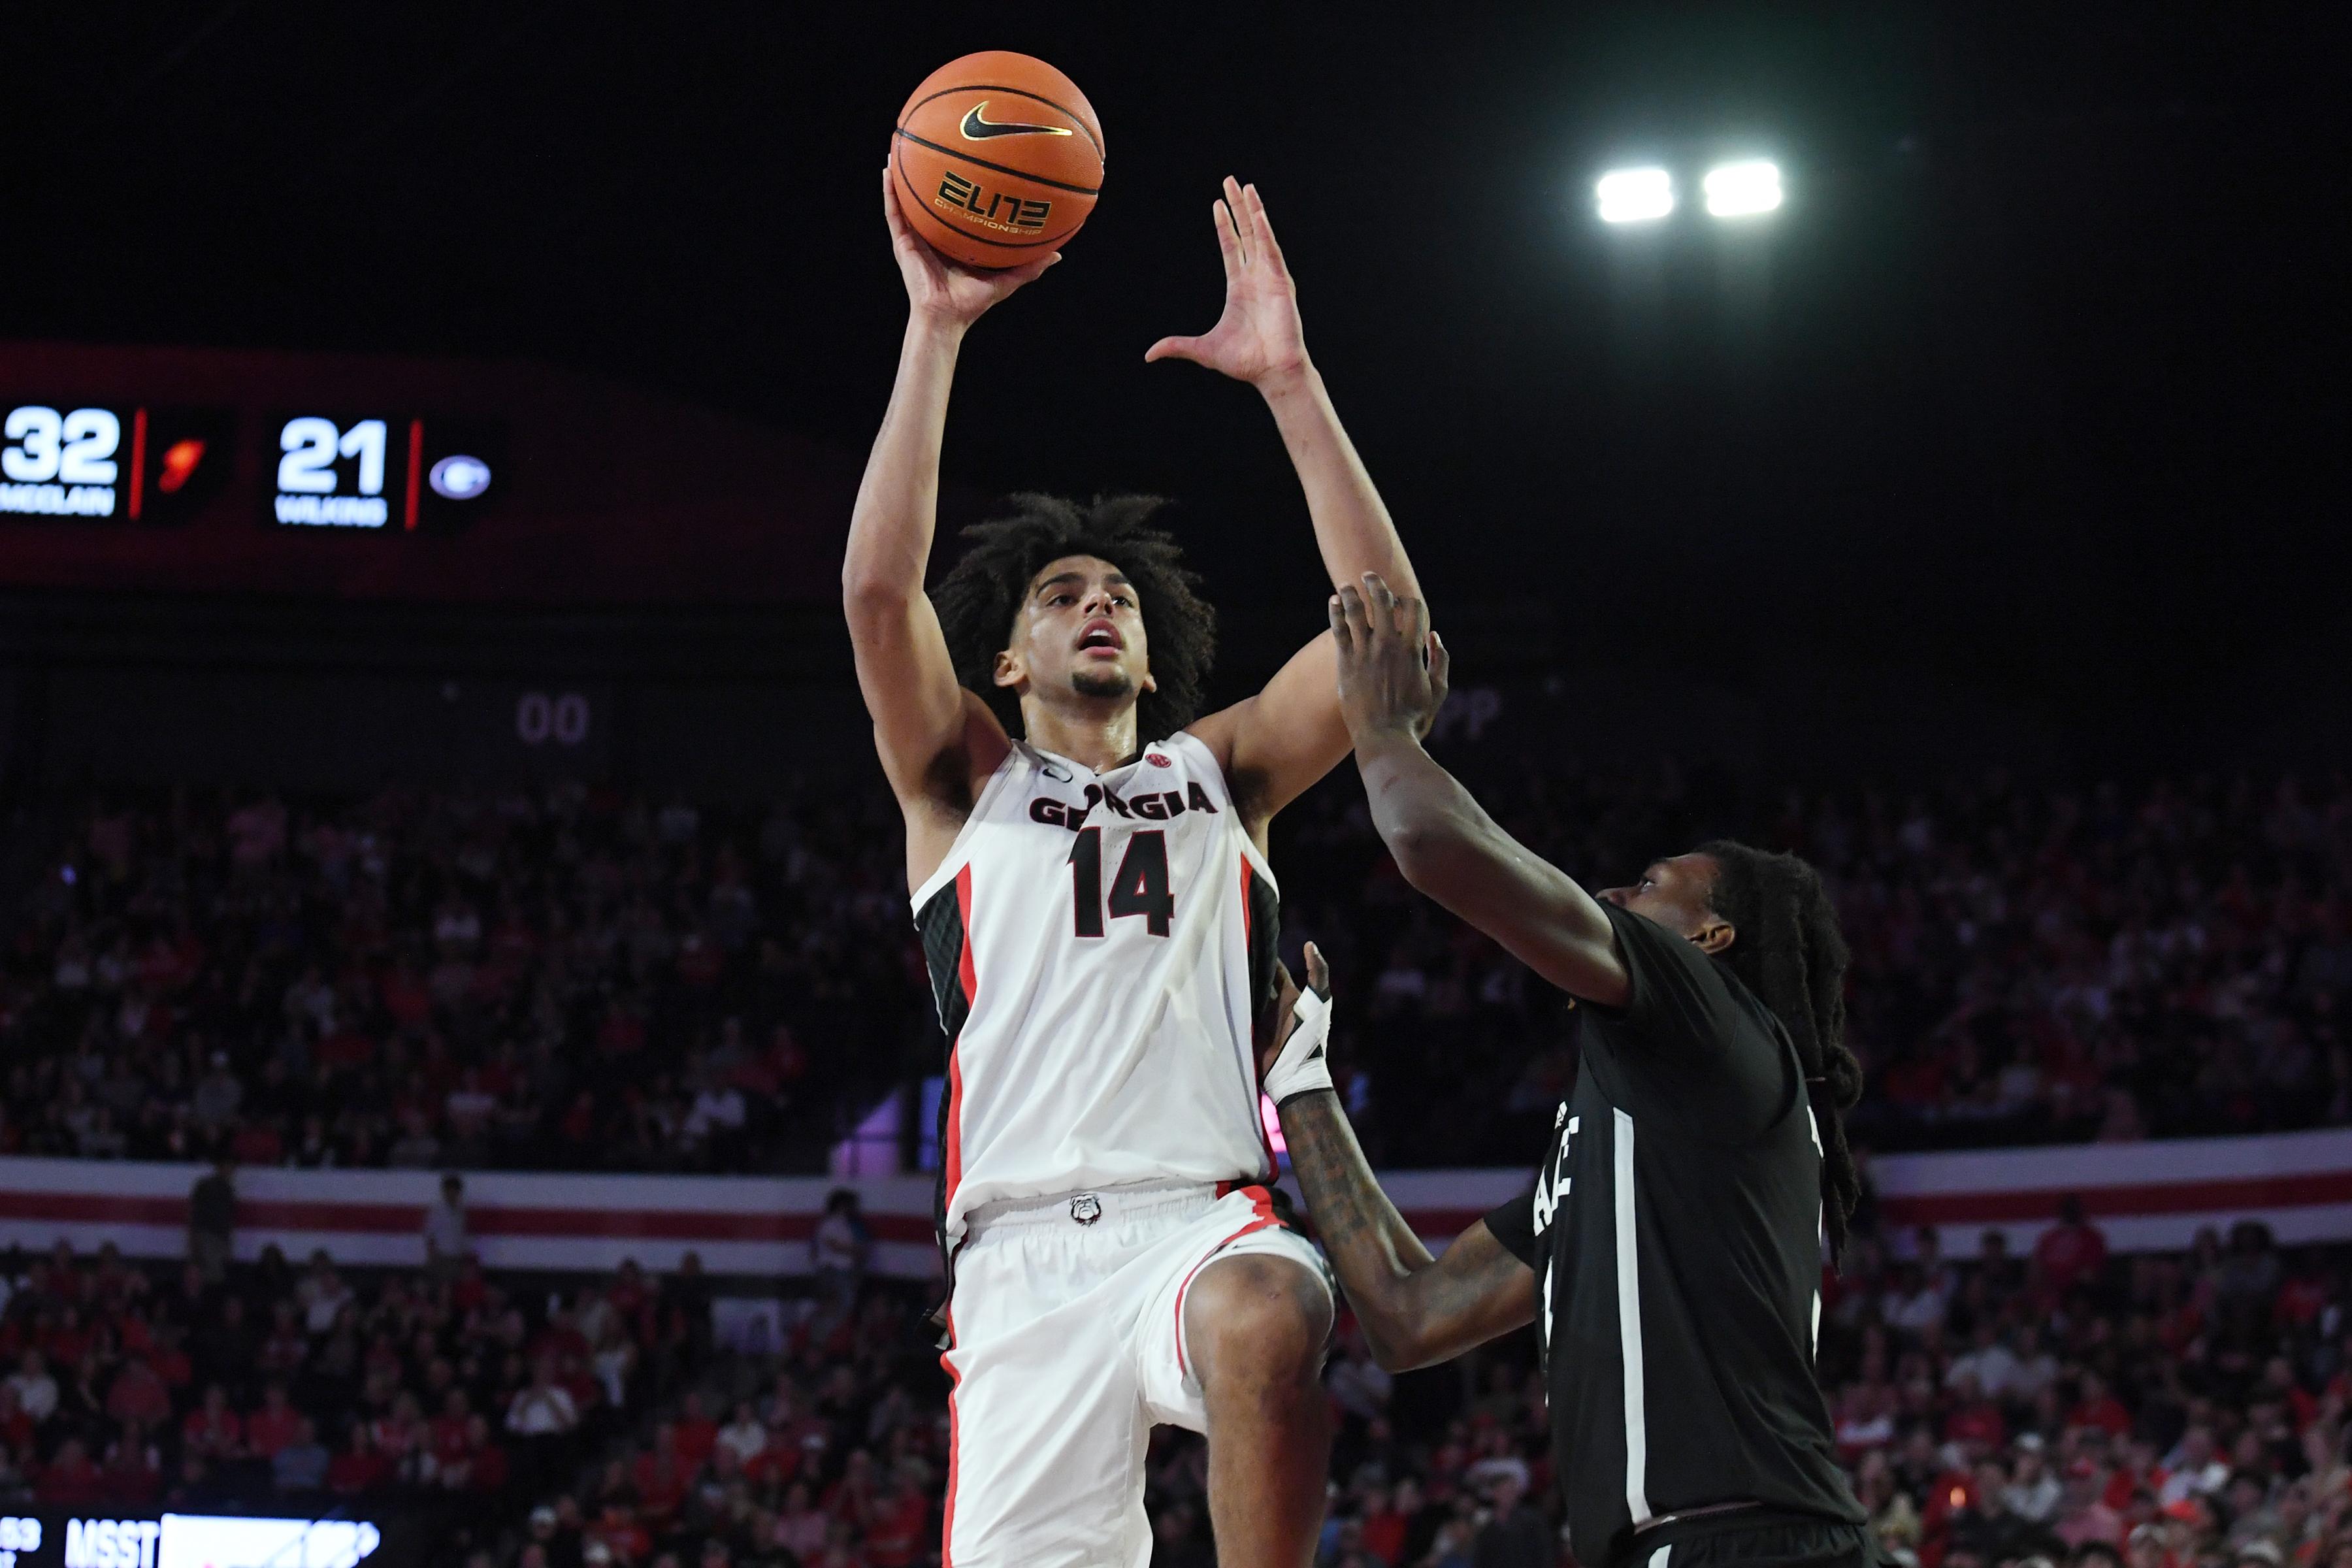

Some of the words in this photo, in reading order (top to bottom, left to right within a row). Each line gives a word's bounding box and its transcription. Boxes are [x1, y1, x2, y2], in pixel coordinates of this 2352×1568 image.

[934, 198, 1043, 235] CHAMPIONSHIP
[937, 170, 1052, 228] ELITE
[1, 405, 120, 484] 32
[277, 416, 387, 497] 21
[1066, 826, 1175, 938] 14
